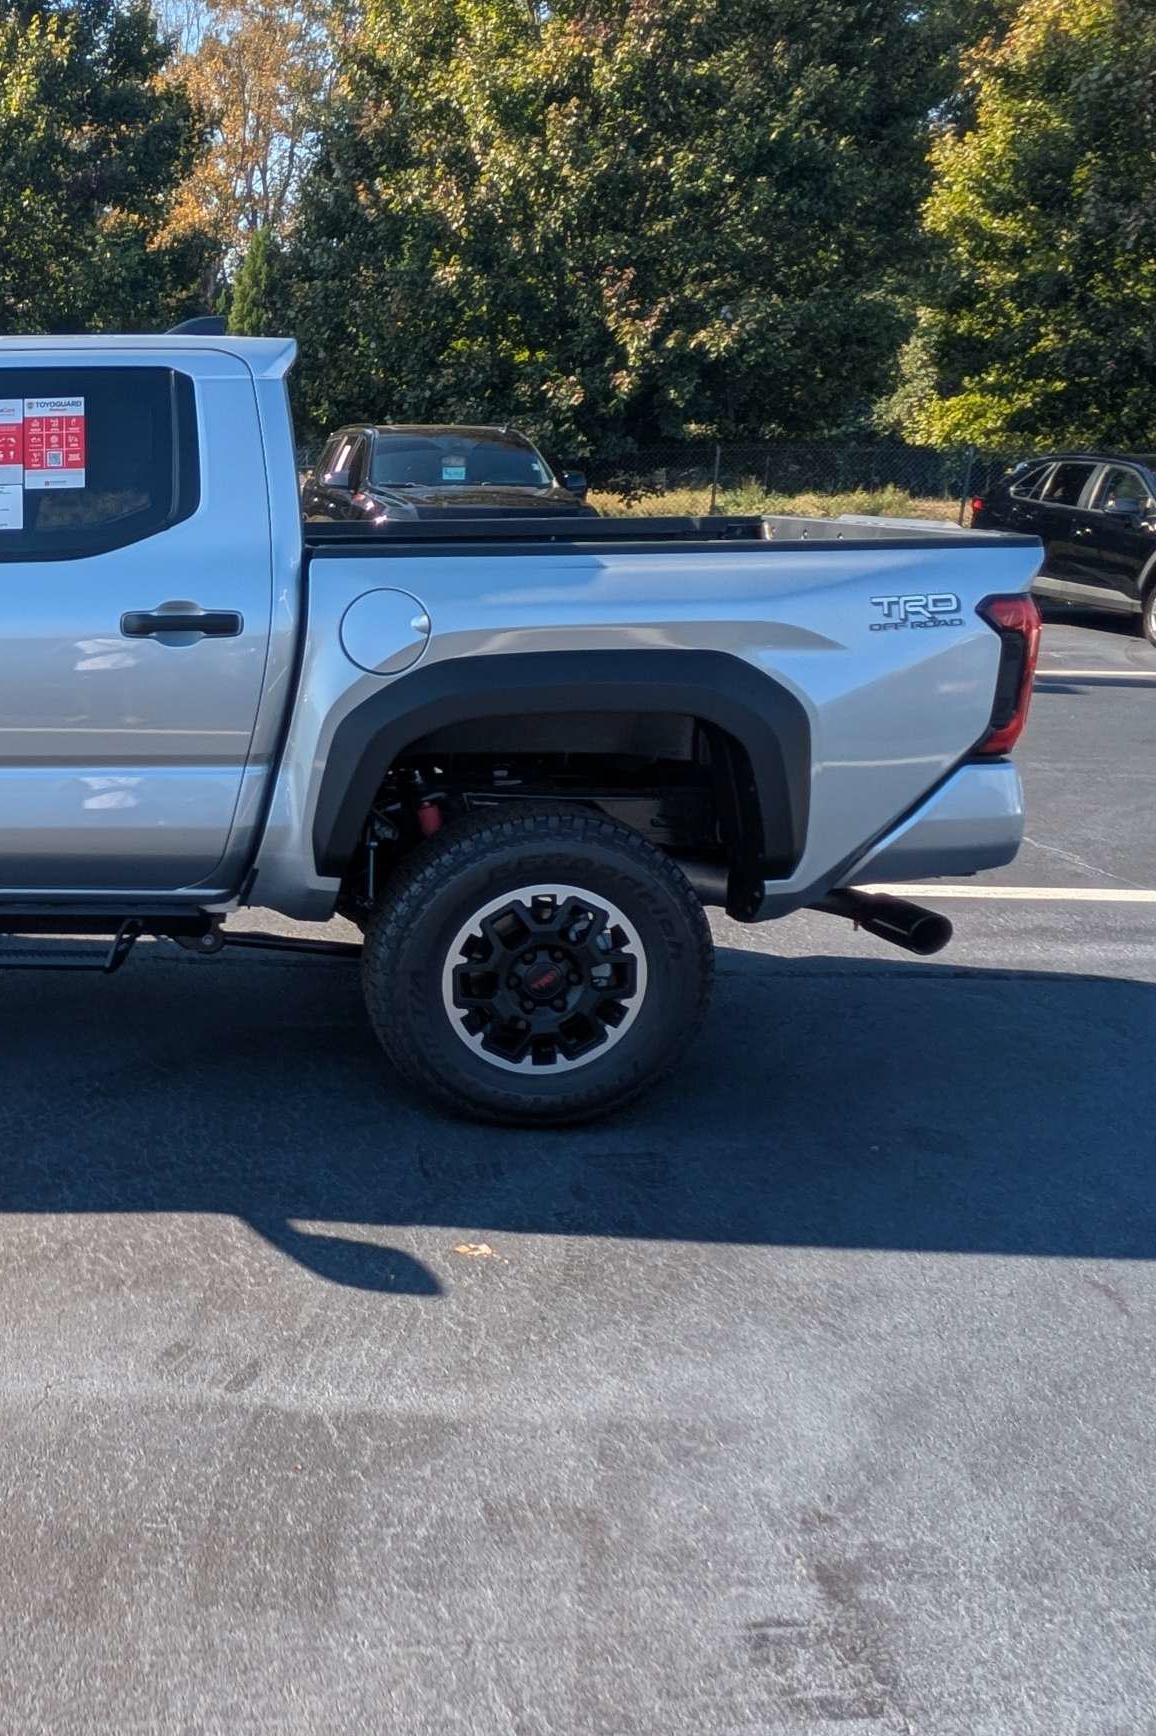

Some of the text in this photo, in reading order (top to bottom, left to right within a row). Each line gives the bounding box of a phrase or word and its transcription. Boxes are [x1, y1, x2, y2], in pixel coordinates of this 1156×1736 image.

[35, 400, 82, 409] TOYOGUARD
[869, 593, 961, 621] TRD
[869, 618, 964, 631] OFF ROAD
